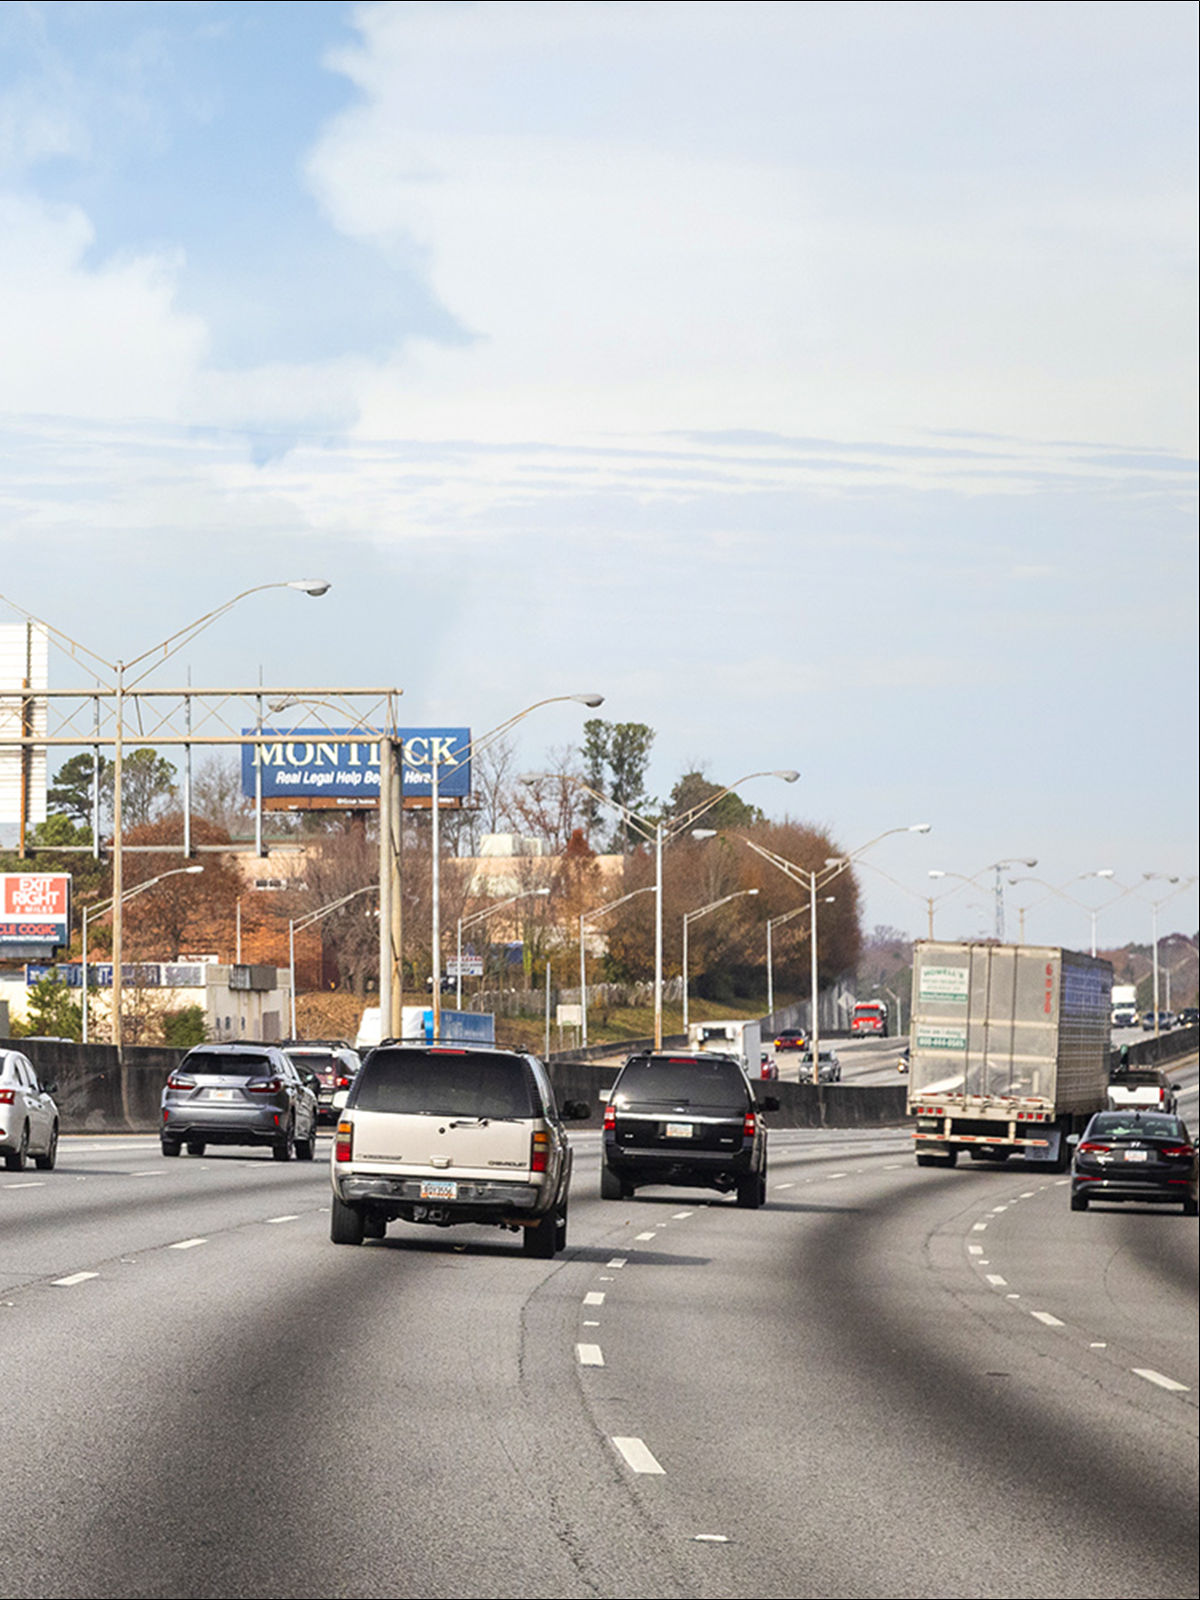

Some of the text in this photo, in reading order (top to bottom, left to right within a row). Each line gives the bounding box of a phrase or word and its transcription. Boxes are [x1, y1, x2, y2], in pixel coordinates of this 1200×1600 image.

[276, 771, 301, 784] Real
[303, 771, 334, 786] Legal
[336, 771, 362, 786] Help
[19, 878, 54, 891] EXIT
[12, 891, 60, 906] RIGHT
[18, 924, 56, 935] COGIC
